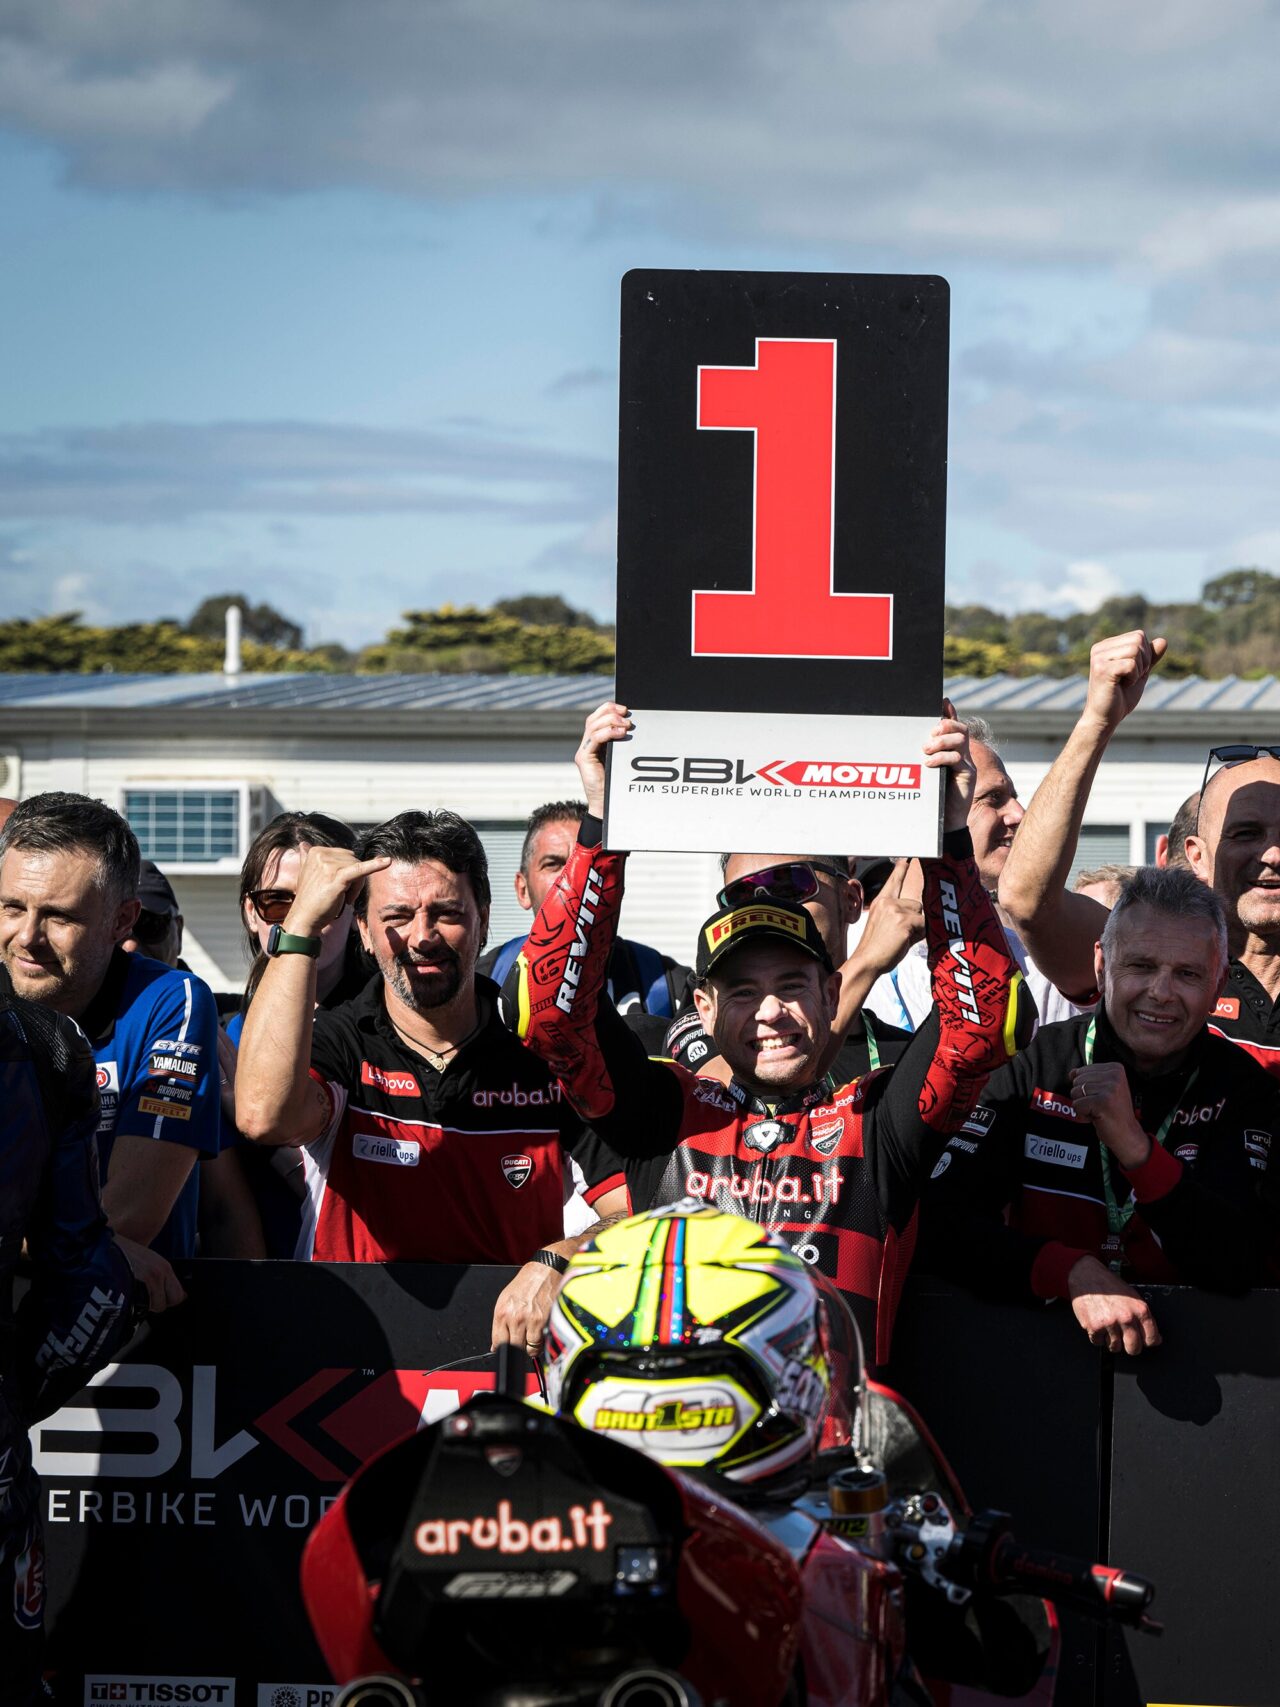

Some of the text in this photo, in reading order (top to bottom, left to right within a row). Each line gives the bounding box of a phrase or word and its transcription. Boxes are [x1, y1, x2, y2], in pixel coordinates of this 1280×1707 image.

[691, 337, 893, 661] 1
[801, 764, 917, 786] MOTUL
[628, 784, 922, 801] FIM SUPERBIKE WORLD CHAMPIONSHIP
[711, 908, 800, 944] PIRELLI
[153, 1056, 198, 1076] YAMALUBE
[367, 1066, 416, 1090] Lenovo
[472, 1082, 562, 1107] aruba.it
[371, 1139, 415, 1164] riello ups
[1038, 1142, 1082, 1164] riello ups
[685, 1163, 845, 1206] aruba.it
[415, 1499, 613, 1554] aruba.it
[129, 1682, 230, 1703] TISSOT
